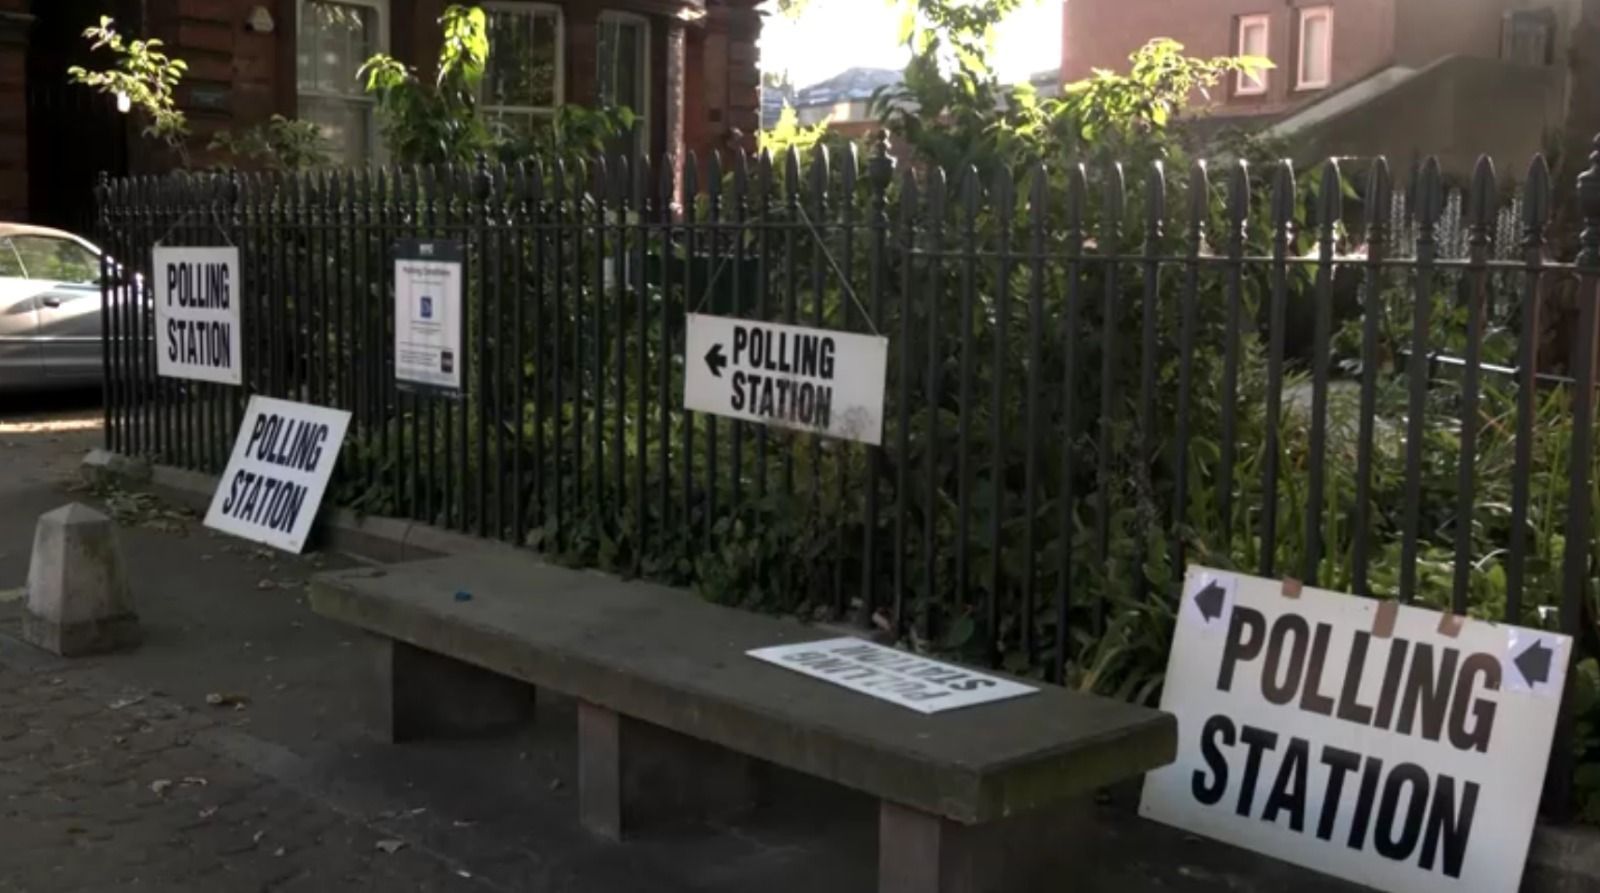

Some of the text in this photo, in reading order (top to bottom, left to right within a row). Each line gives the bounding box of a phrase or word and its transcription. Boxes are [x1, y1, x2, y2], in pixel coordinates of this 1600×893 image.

[167, 262, 230, 309] POLLING
[168, 318, 231, 368] STATION
[733, 326, 835, 379] POLLING
[731, 371, 833, 430] STATION
[245, 413, 329, 472] POLLING
[222, 469, 308, 534] STATION
[781, 651, 953, 701] POLLING
[831, 644, 997, 691] STATION
[1216, 605, 1502, 754] POLLING
[1191, 714, 1480, 879] STATION
